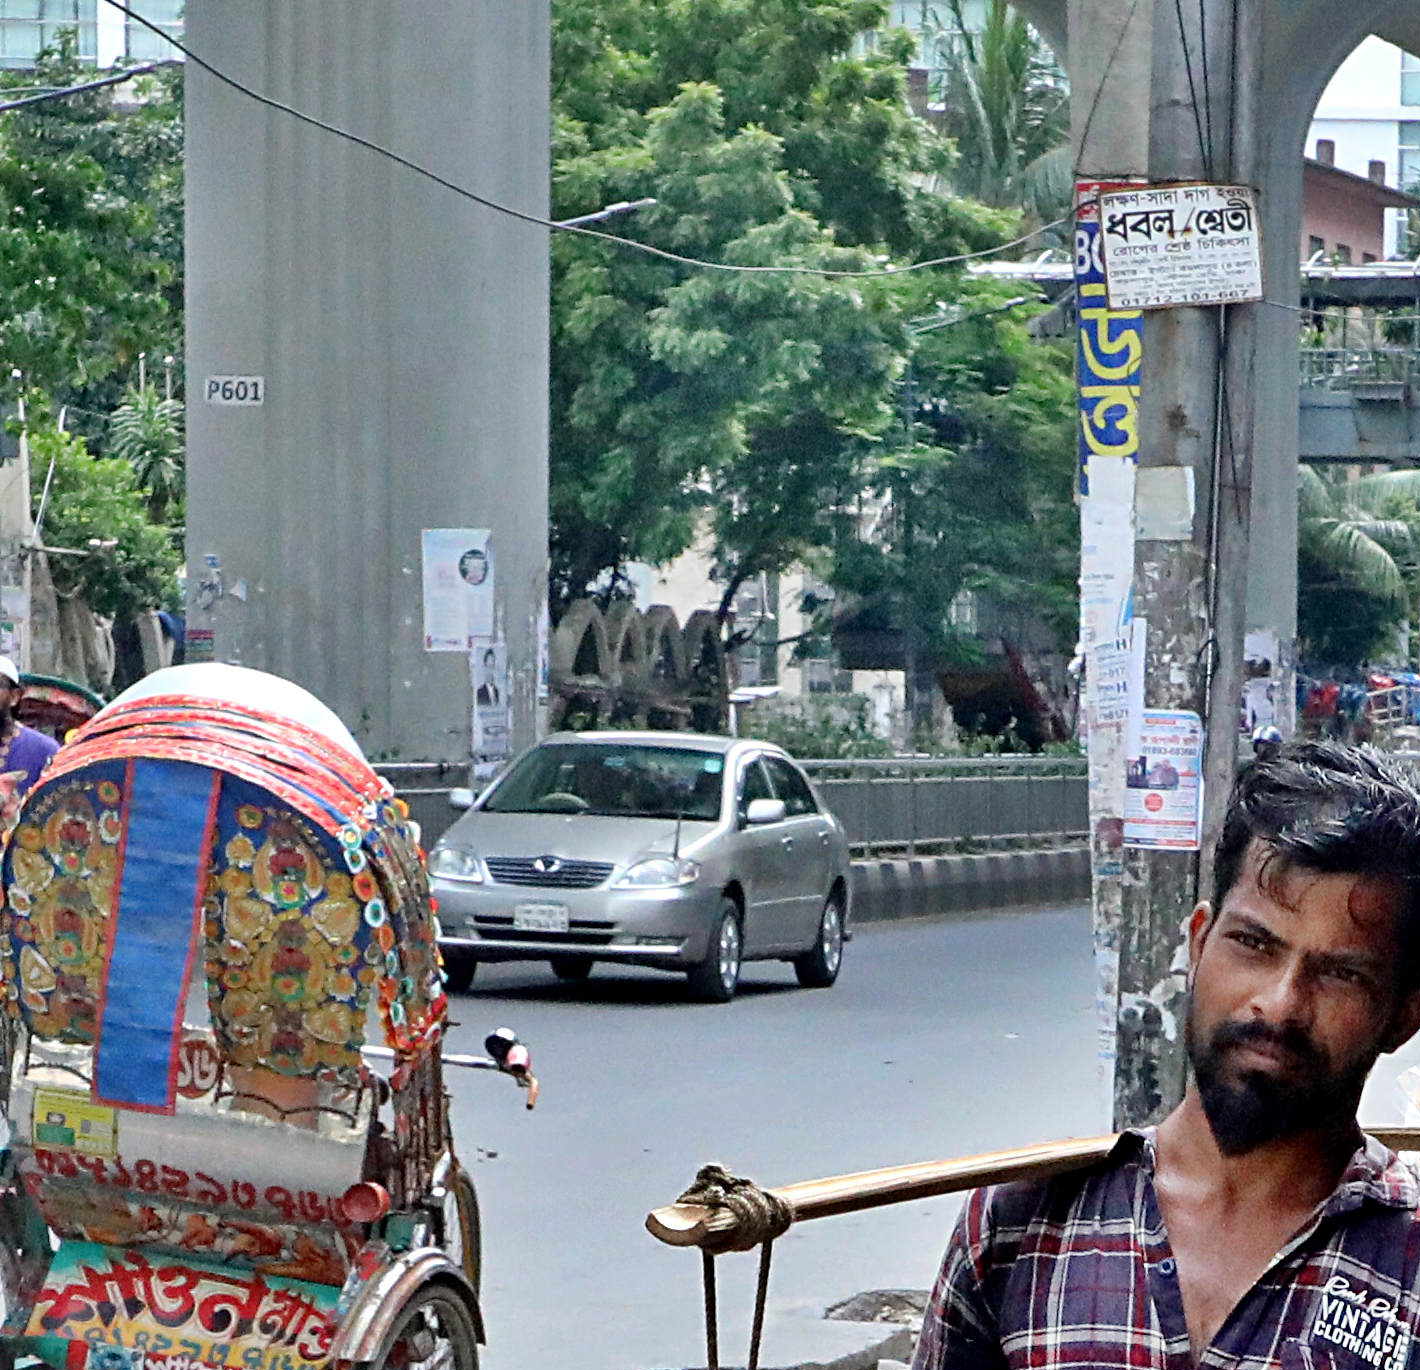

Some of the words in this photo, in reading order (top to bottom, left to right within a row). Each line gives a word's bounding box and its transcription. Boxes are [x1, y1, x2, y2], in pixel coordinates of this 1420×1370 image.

[1106, 209, 1176, 241] ধবল
[1196, 197, 1252, 236] শ্বেতী
[1113, 244, 1158, 257] রোগের
[1197, 236, 1250, 251] চিকিৎসা
[208, 380, 261, 401] P601
[1313, 1320, 1383, 1367] CLOTHING
[1321, 1294, 1409, 1361] VINTAGE
